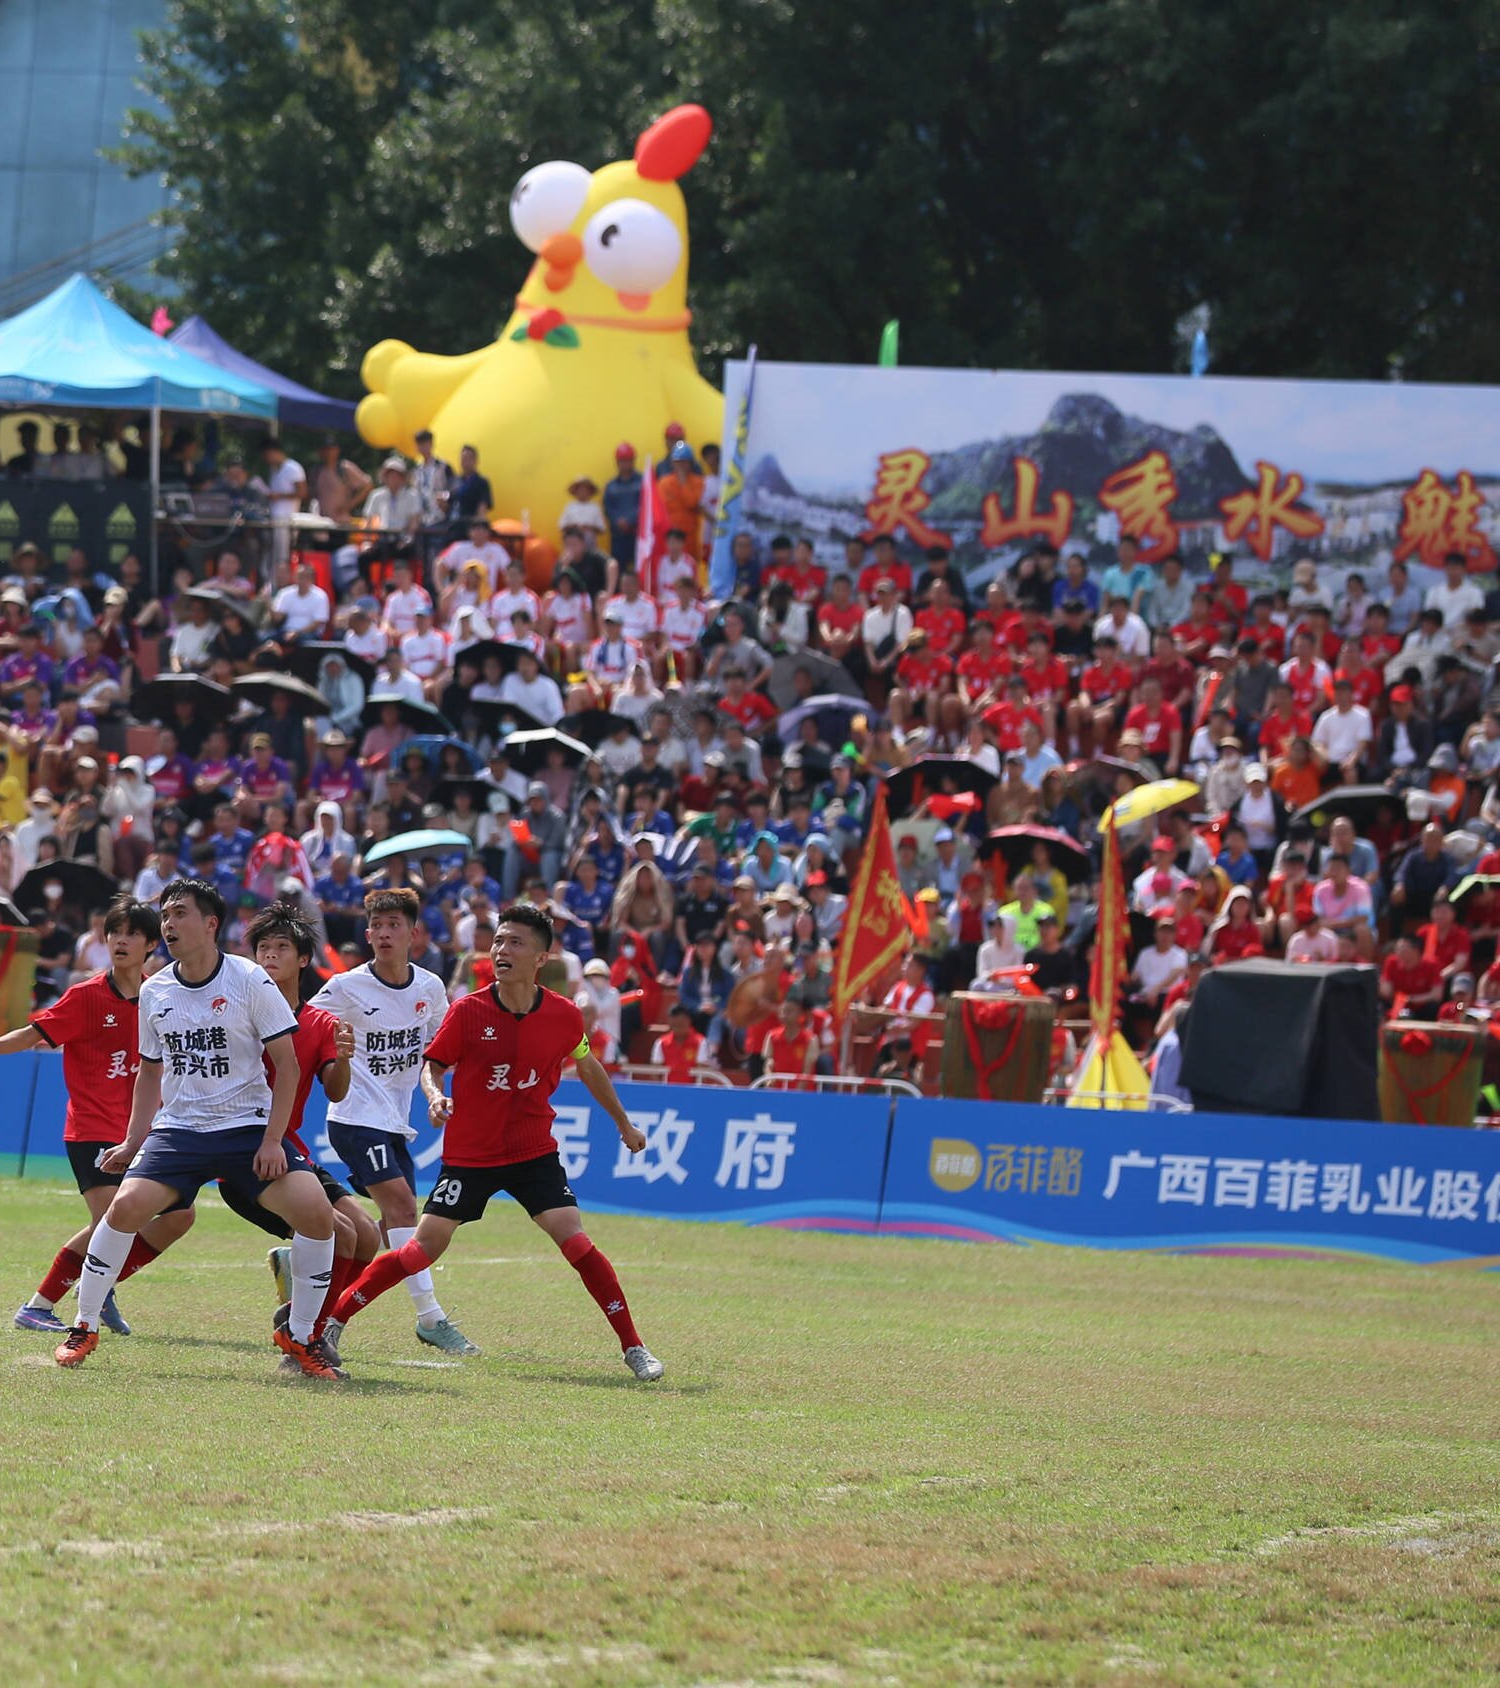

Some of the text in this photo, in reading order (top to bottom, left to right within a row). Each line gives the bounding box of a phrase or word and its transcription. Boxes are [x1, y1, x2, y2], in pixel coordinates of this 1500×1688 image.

[861, 447, 1499, 573] 灵山秀水魅
[164, 1026, 227, 1053] 防城港
[171, 1054, 230, 1078] 东兴市
[368, 1049, 419, 1076] 东兴市
[486, 1064, 540, 1091] 灵山
[366, 1143, 389, 1172] 17
[432, 1178, 463, 1206] 29
